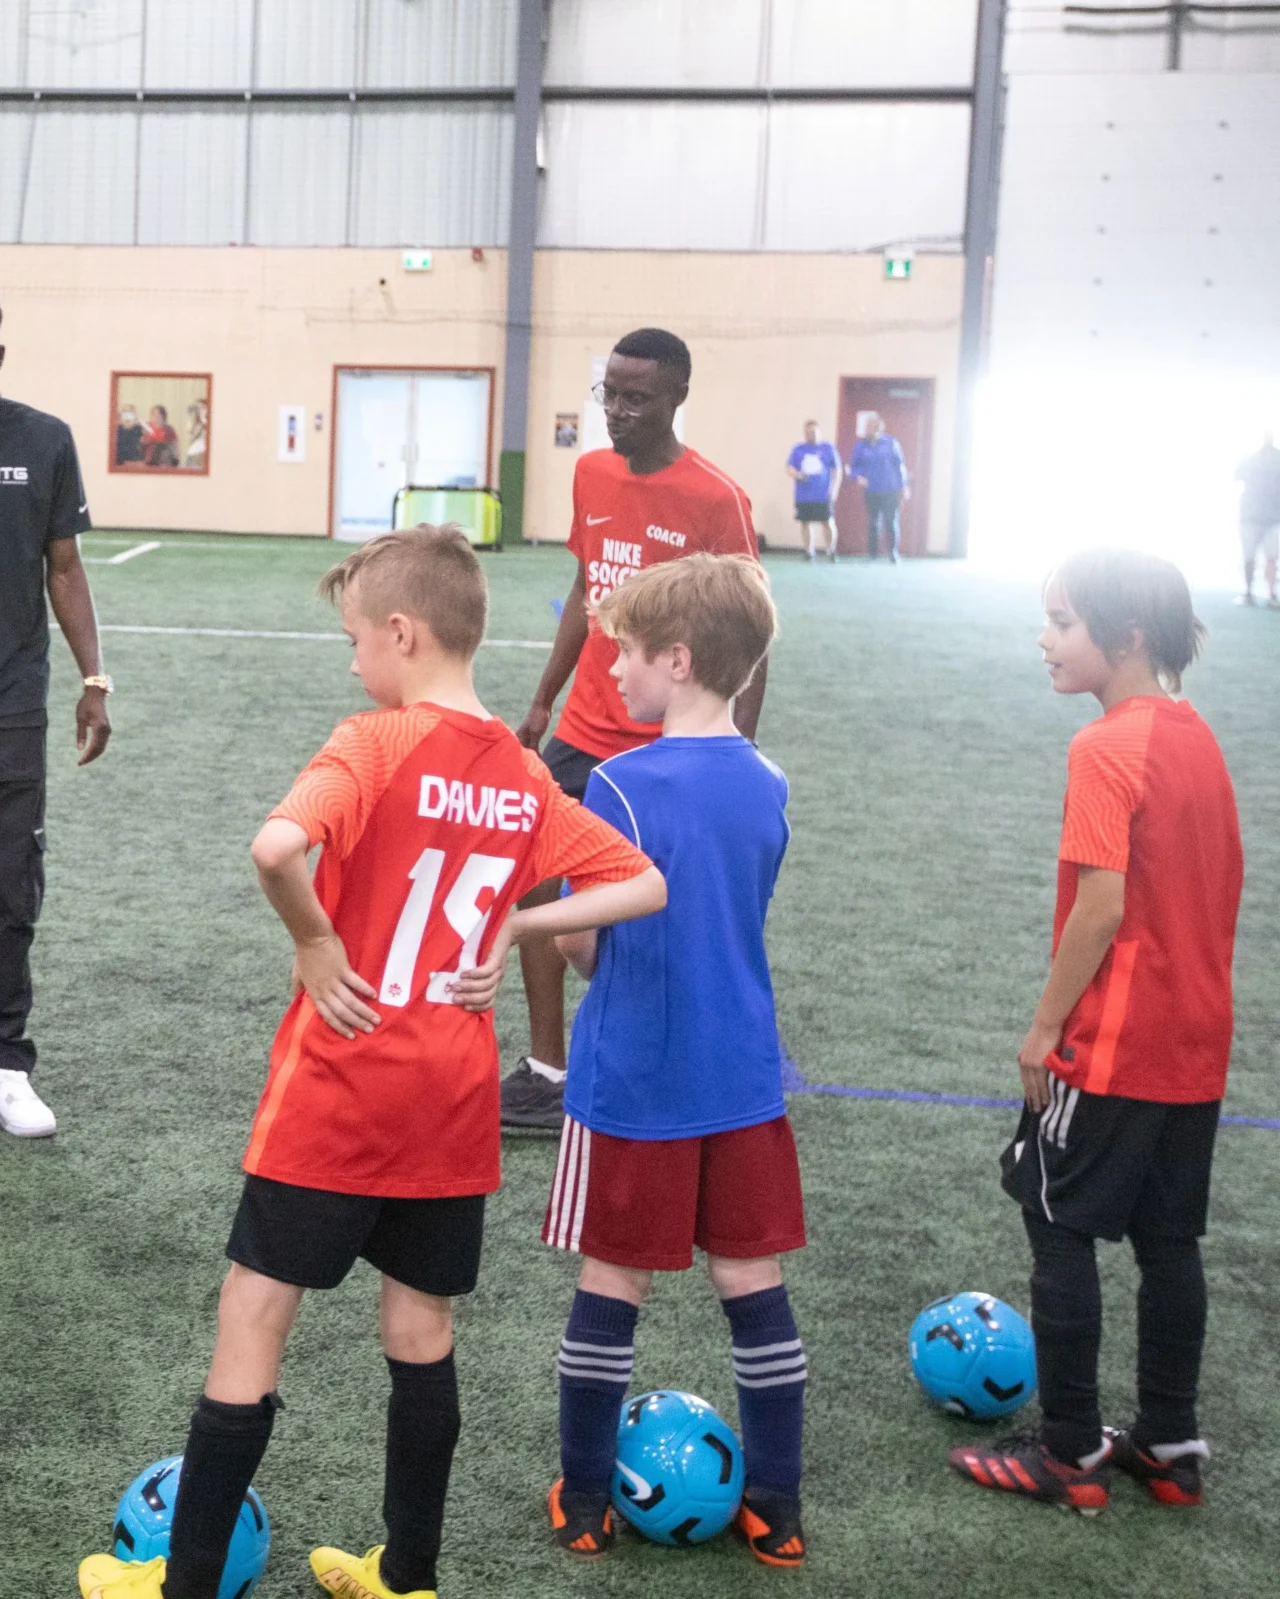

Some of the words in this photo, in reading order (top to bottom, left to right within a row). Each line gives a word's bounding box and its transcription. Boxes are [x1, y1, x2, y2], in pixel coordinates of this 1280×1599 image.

[646, 524, 686, 548] COACH
[602, 538, 642, 567] NIKE
[417, 774, 539, 832] DAVIES
